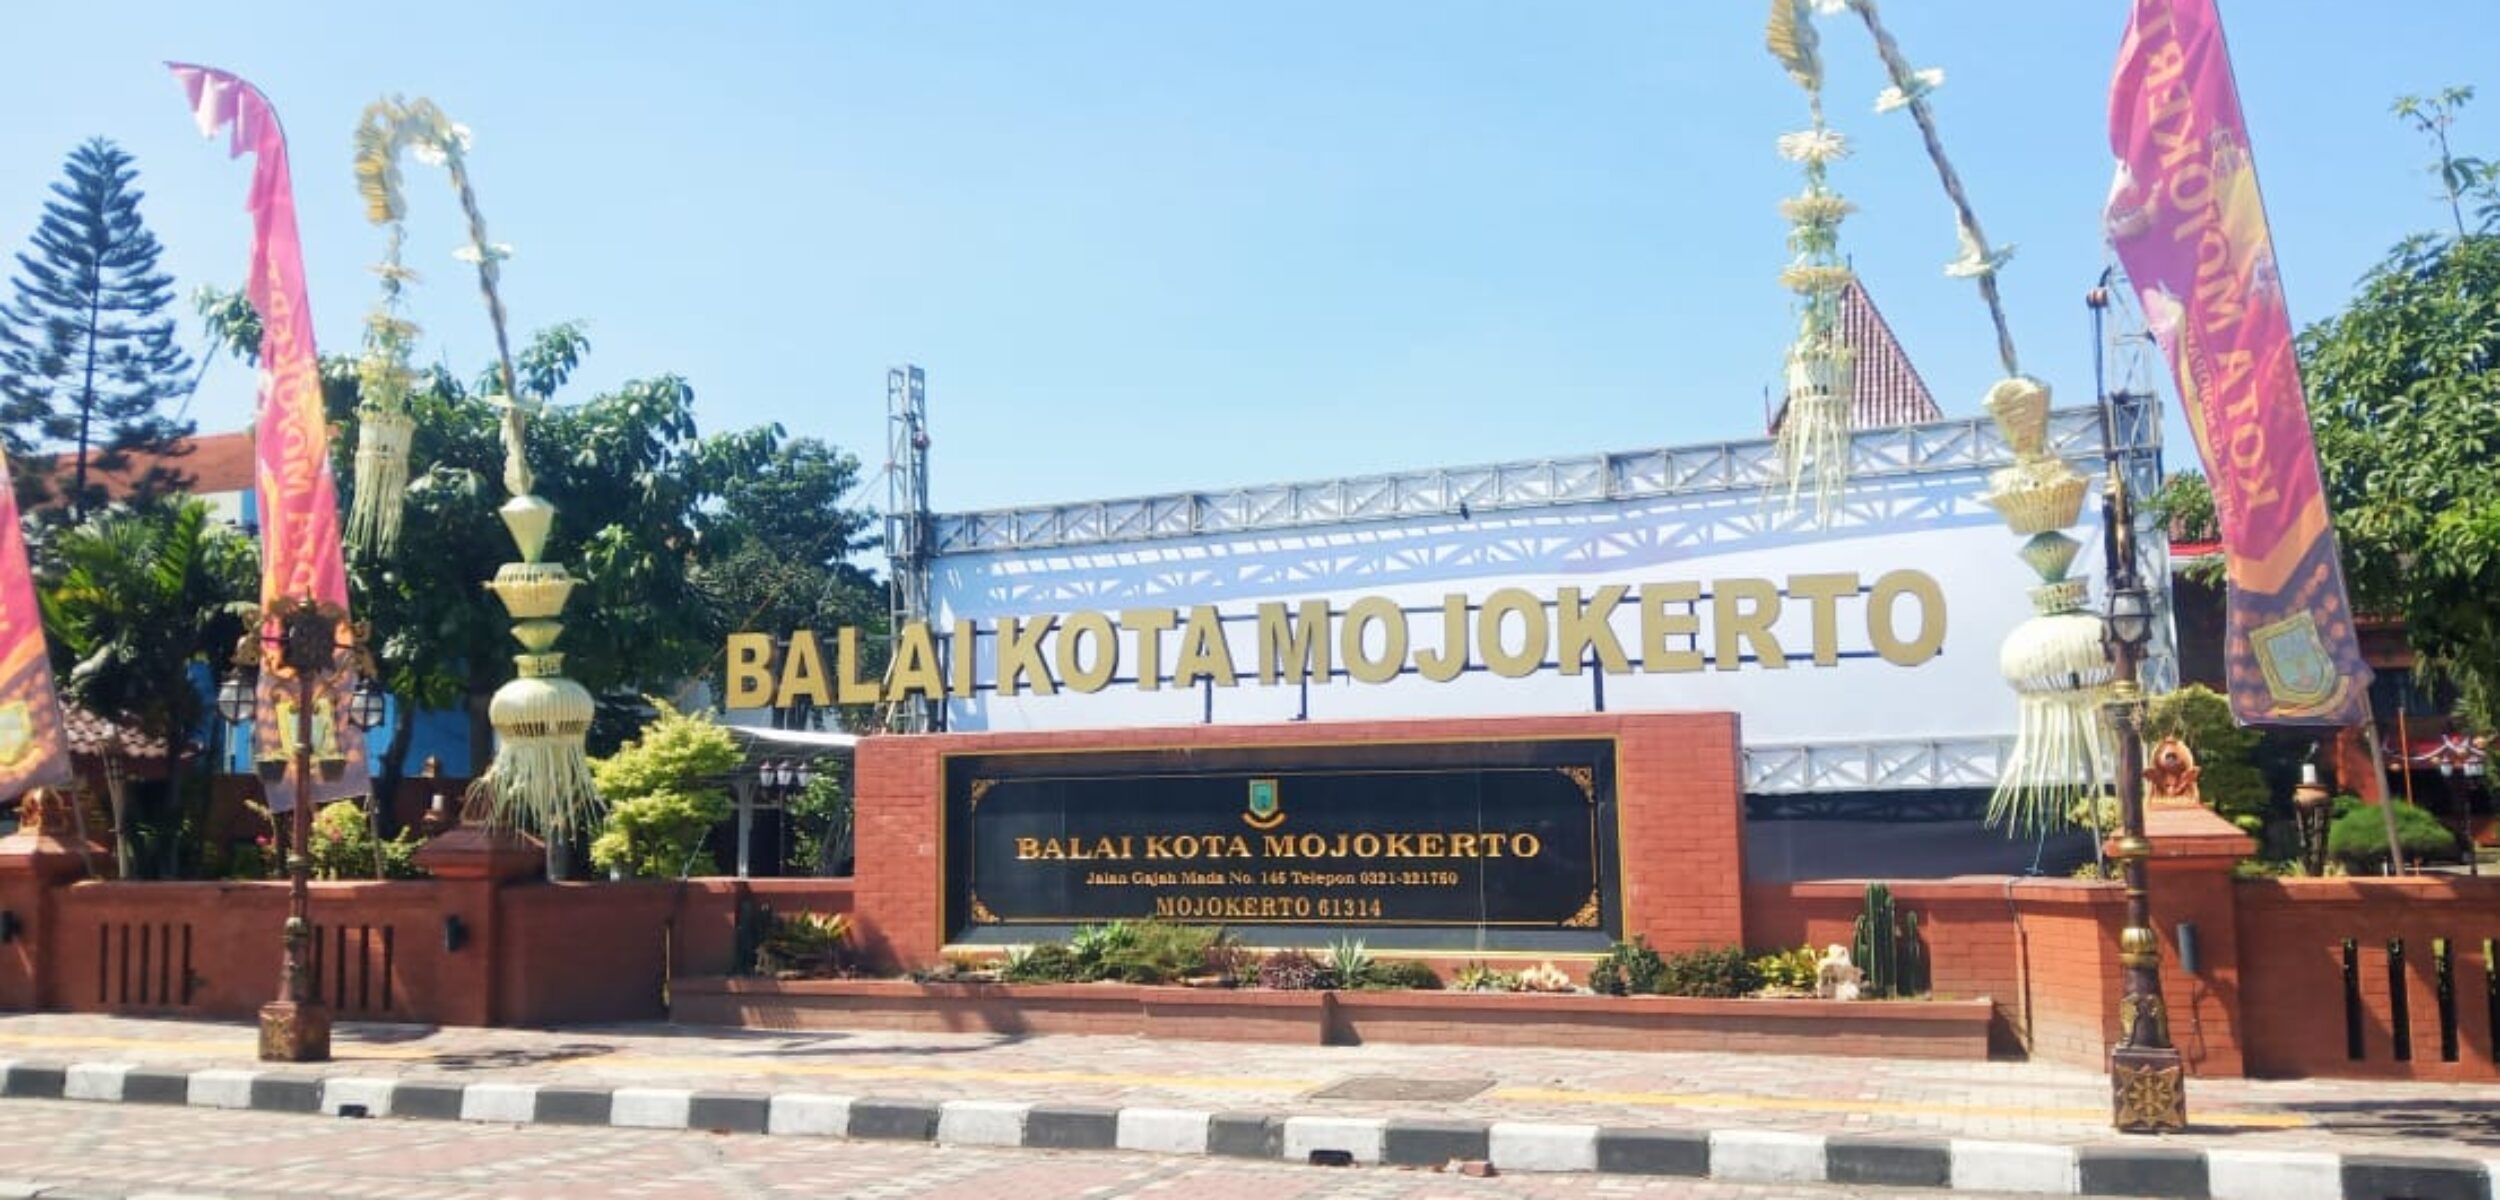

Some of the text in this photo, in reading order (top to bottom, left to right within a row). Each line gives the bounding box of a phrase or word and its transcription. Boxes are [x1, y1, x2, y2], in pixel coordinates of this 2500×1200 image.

[726, 568, 1948, 710] BALAI KOTA MOJOKERTO
[1015, 832, 1541, 860] BALAI KOTA MOJOKERTO
[1086, 871, 1128, 885] Jalan
[1131, 870, 1177, 887] Gajah
[1181, 870, 1225, 885] Mada
[1292, 871, 1357, 887] Telepon
[1156, 896, 1383, 918] MOJOKERTO 61314
